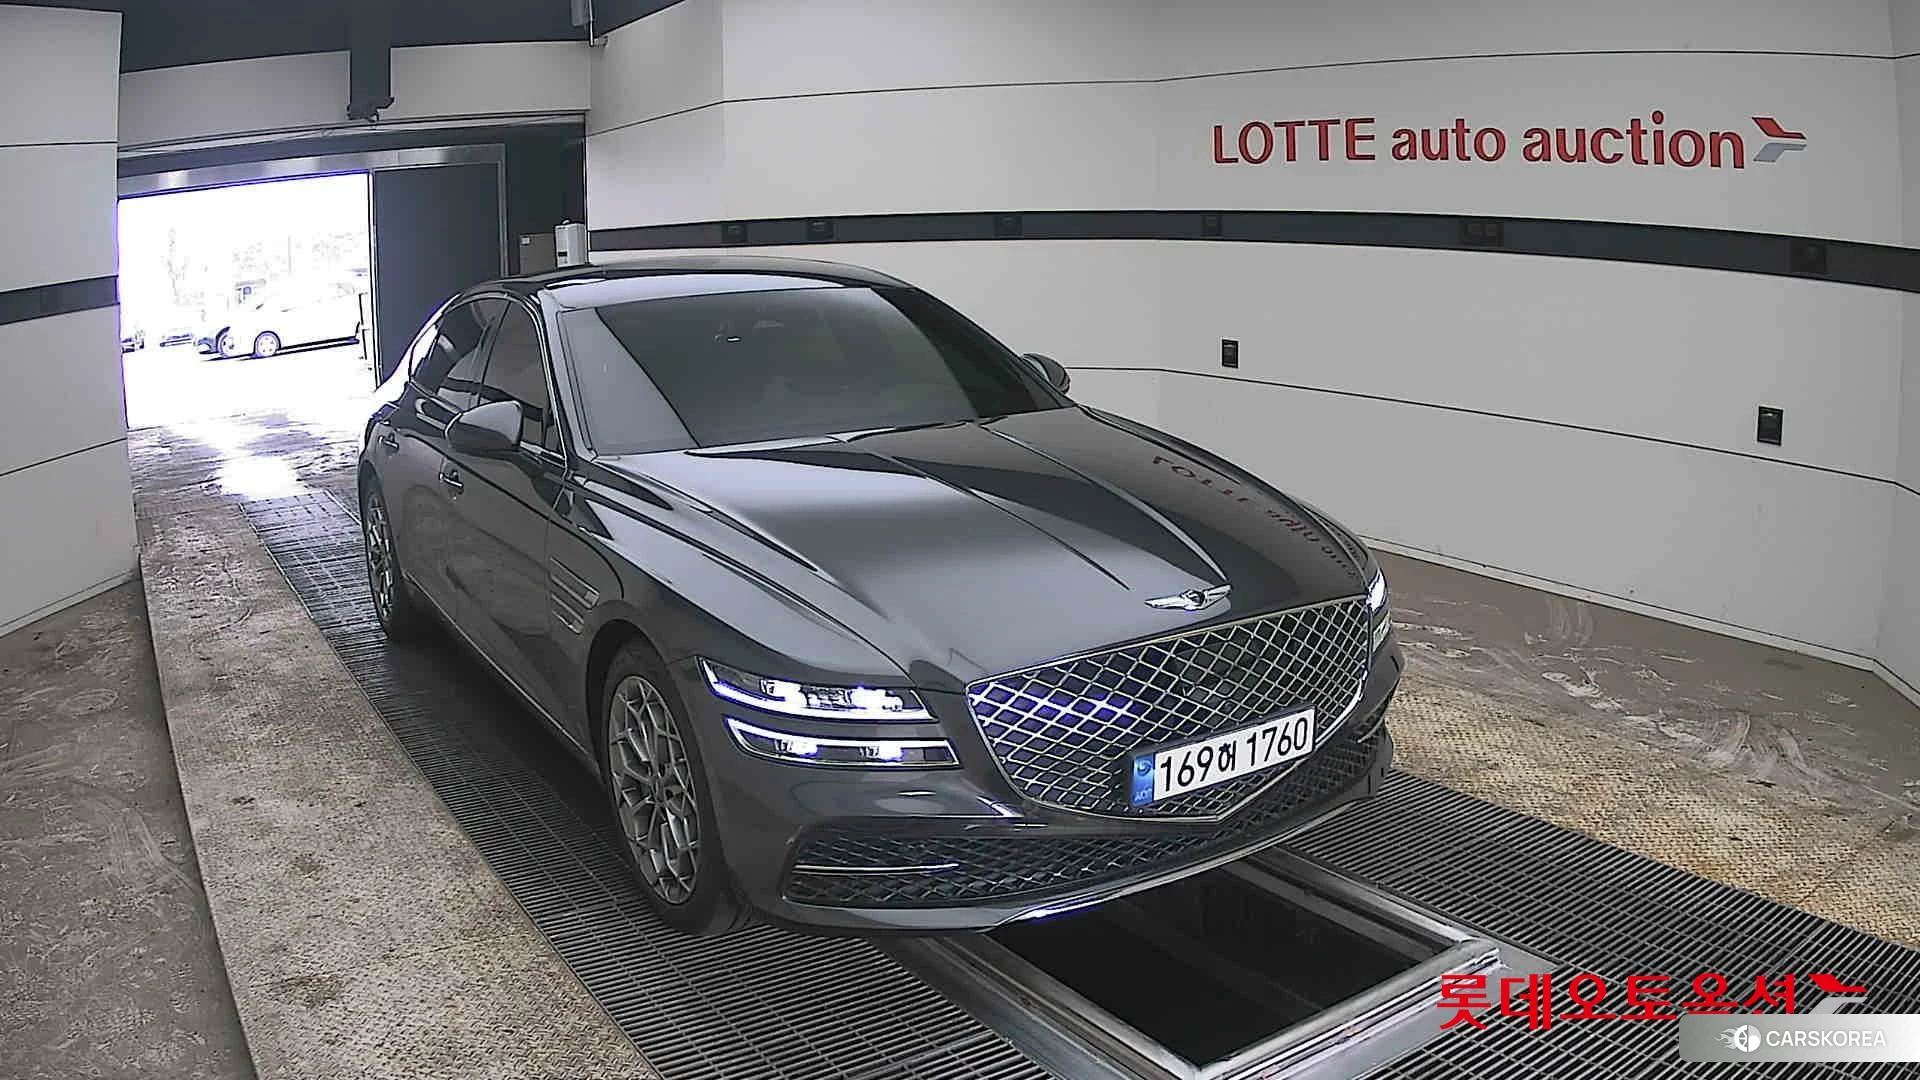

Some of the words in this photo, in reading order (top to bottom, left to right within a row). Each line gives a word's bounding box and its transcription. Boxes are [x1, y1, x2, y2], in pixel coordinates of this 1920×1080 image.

[1213, 117, 1376, 164] LOTTE
[1392, 117, 1507, 163] auto
[1522, 110, 1745, 169] auction
[1160, 740, 1237, 792] 169허
[1246, 717, 1308, 767] 1760
